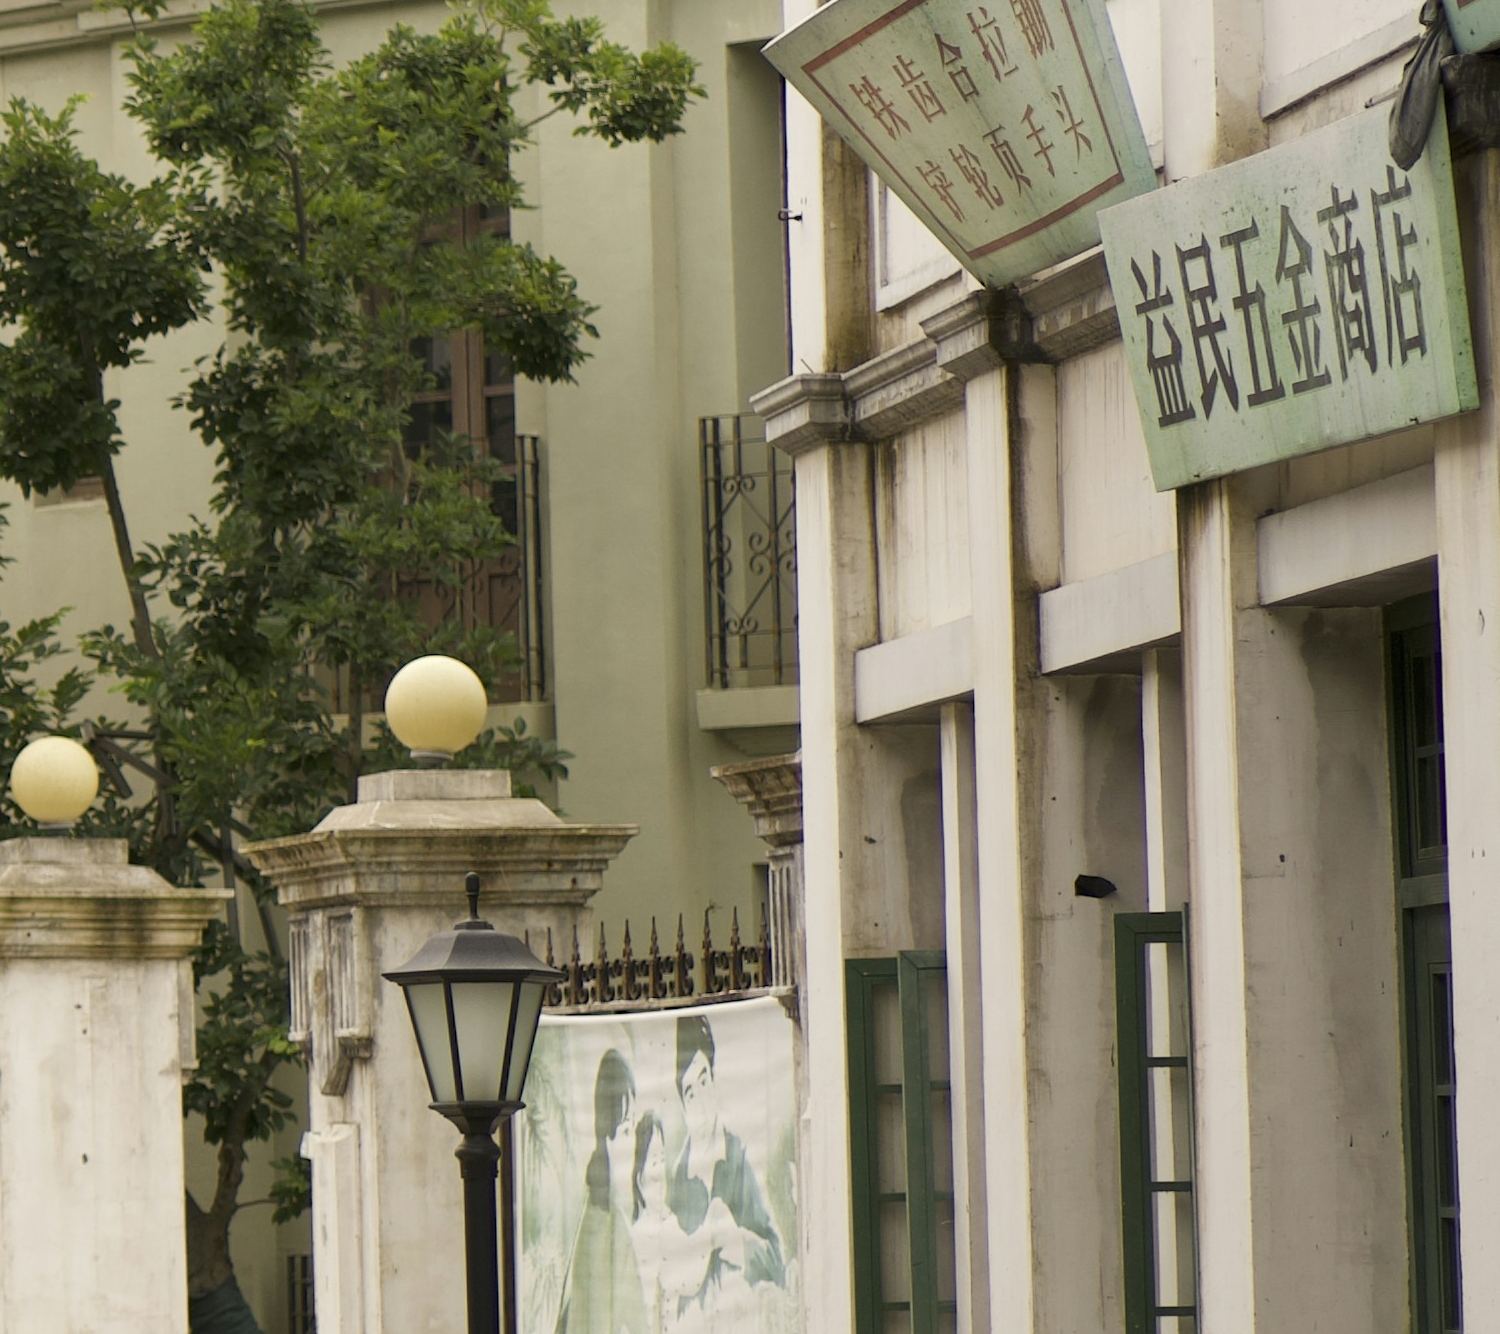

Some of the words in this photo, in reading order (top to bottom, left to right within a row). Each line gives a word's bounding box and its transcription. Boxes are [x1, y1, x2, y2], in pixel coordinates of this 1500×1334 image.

[1130, 164, 1428, 428] 益民五金商店
